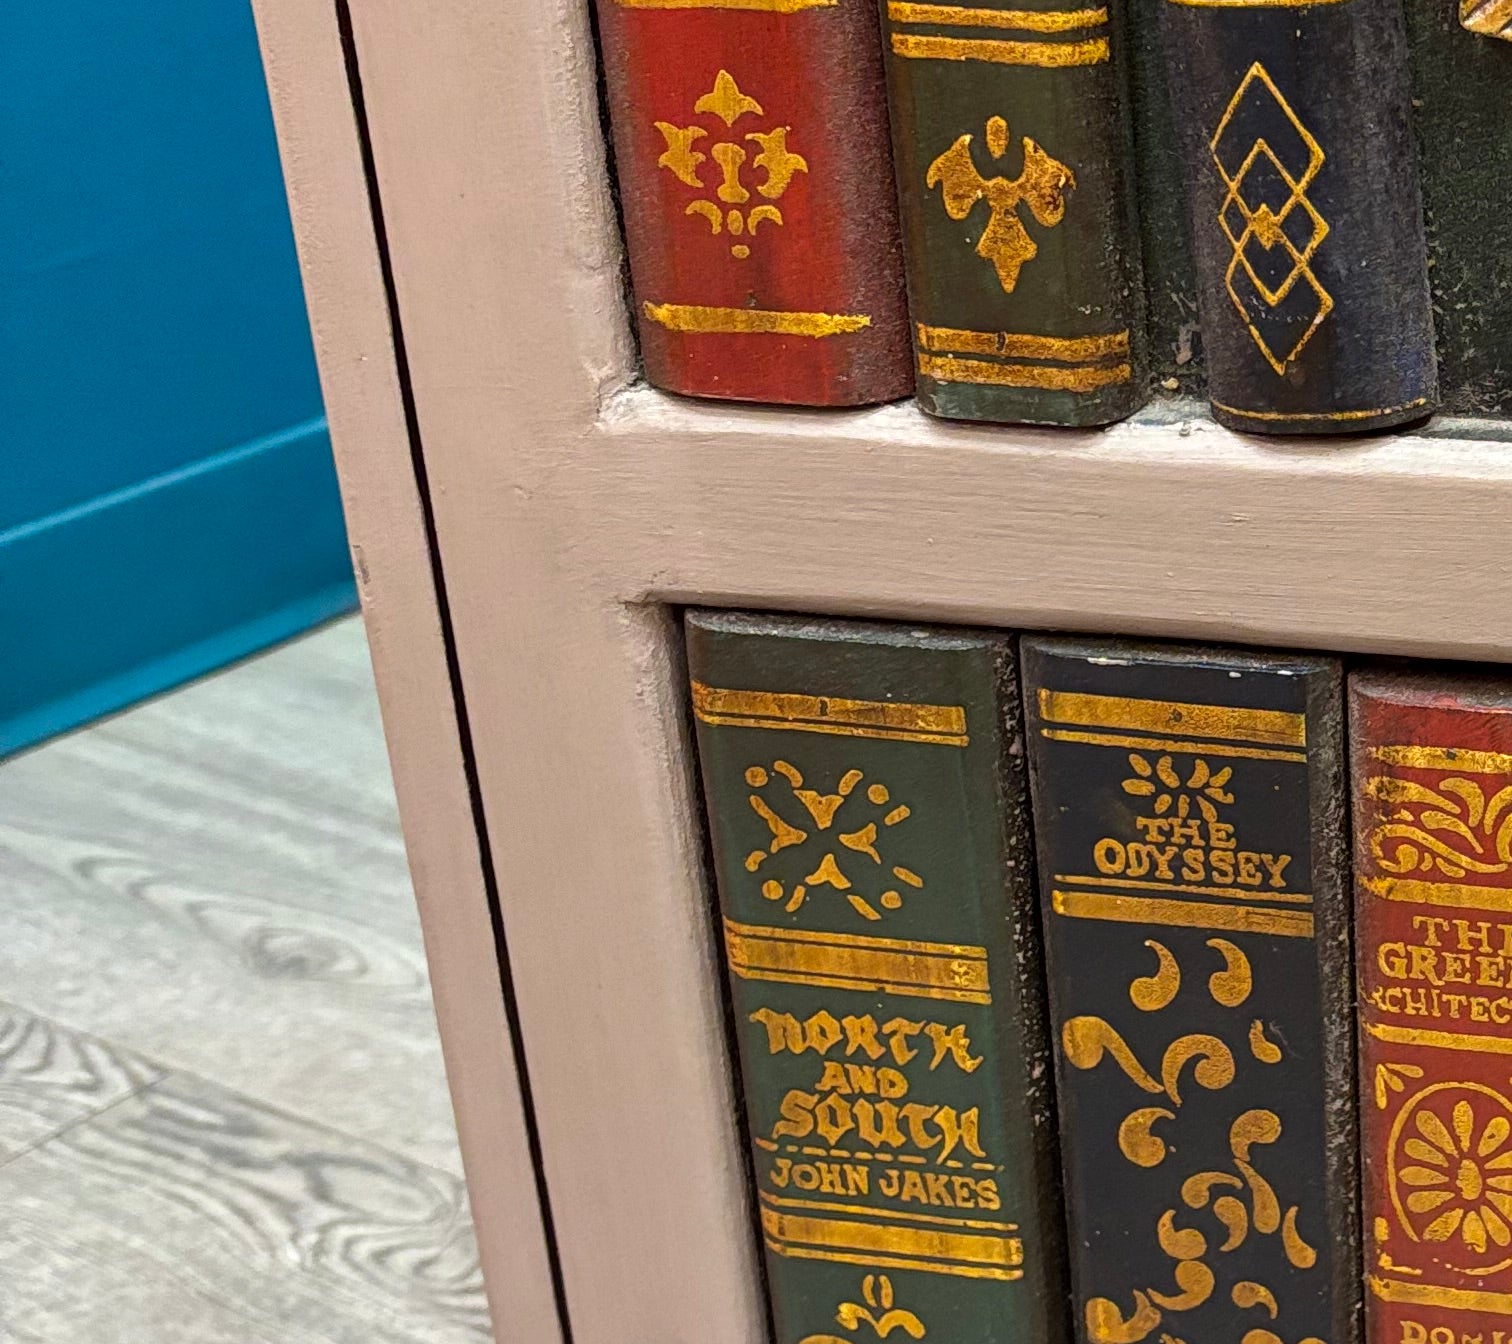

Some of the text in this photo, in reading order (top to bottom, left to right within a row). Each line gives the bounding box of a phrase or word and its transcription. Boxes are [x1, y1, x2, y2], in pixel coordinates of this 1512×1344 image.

[1136, 816, 1237, 850] THE
[1093, 837, 1292, 888] ODYSSEY
[749, 1007, 984, 1073] NORTH
[815, 1060, 909, 1099] AND
[772, 1089, 986, 1165] SOUTH
[770, 1158, 1001, 1211] JOHN JAKES
